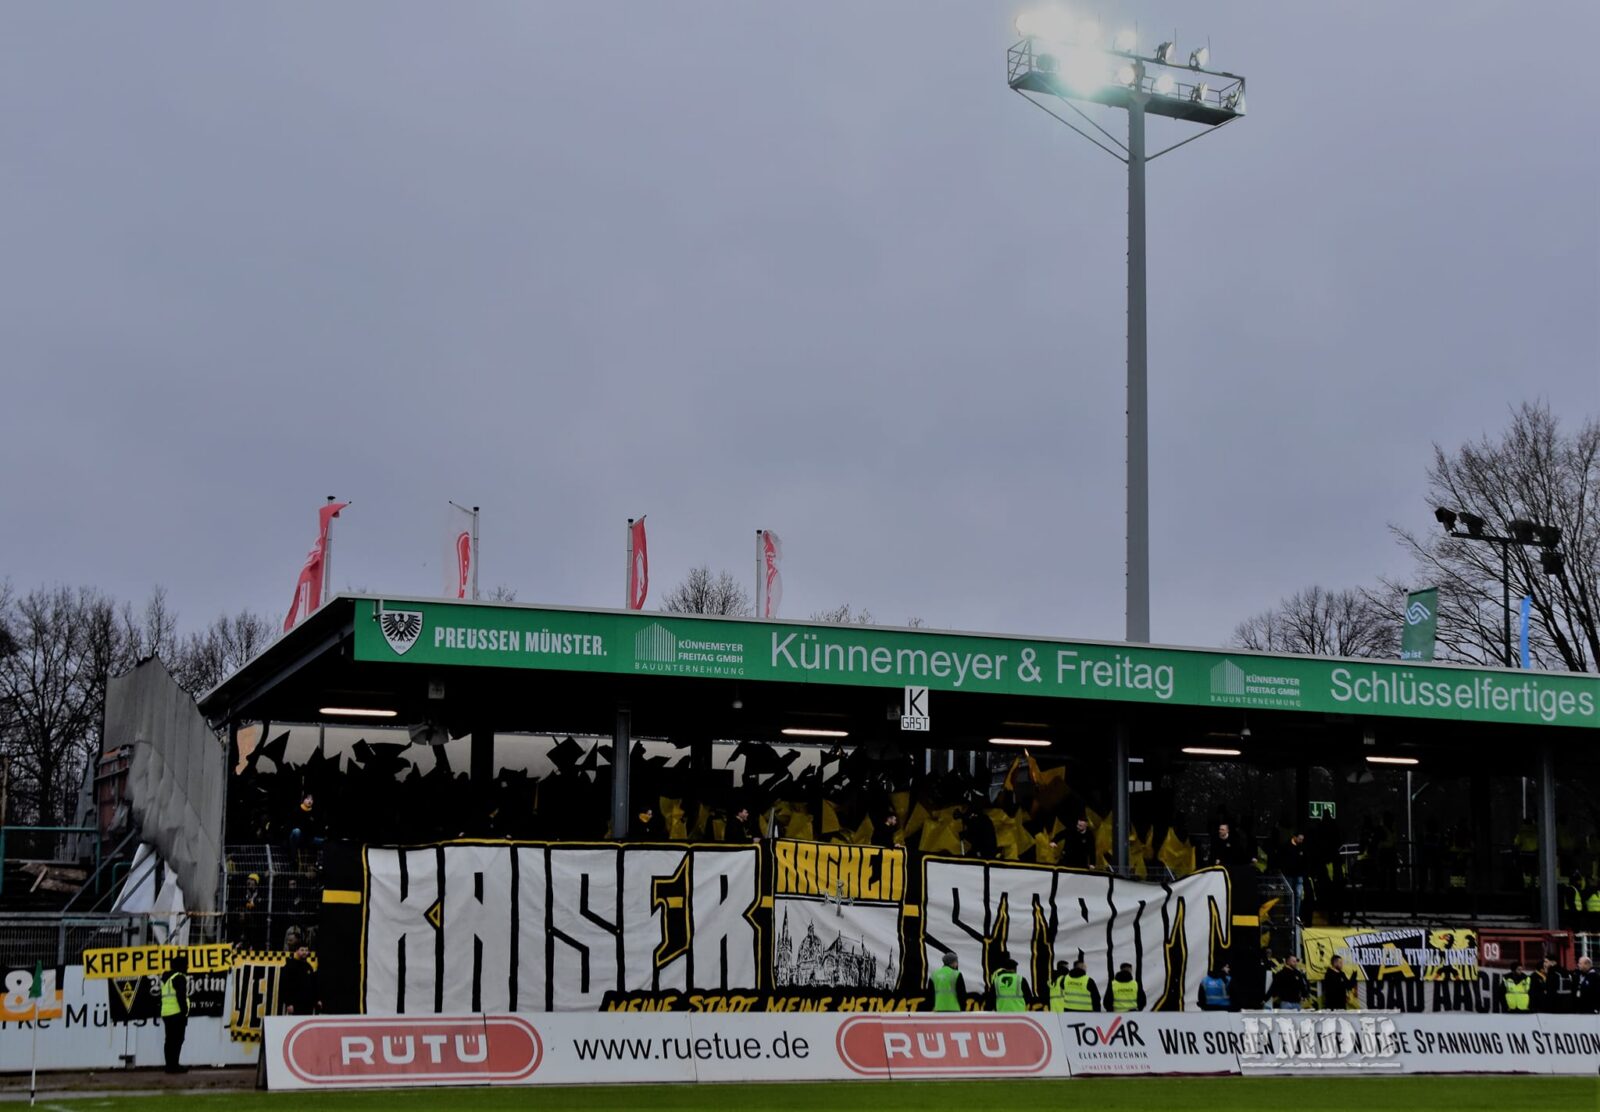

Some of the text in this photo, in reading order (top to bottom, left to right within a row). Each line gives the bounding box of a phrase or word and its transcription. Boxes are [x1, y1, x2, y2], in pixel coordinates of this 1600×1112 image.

[434, 626, 608, 656] PREUSSEN MÜNSTER.
[678, 640, 744, 653] KÜNNEMEYER
[634, 662, 745, 675] BAUUNTERNEHMUNG
[678, 652, 743, 663] FREITAG GMBH
[771, 631, 1174, 699] Künnemeyer & Freitag
[1246, 674, 1300, 686] KÜNNEMEYER
[1246, 686, 1300, 697] FREITAG GMBH
[909, 689, 924, 717] K
[1330, 668, 1594, 722] Schlüsselfertiges
[902, 716, 929, 730] GAST
[775, 842, 903, 900] AACHEN
[367, 846, 759, 1012] KAISER
[1483, 942, 1500, 961] 09
[341, 1034, 488, 1065] RÜTÜ
[573, 1031, 810, 1061] www.ruetue.de
[883, 1032, 1007, 1060] RÜTÜ
[1158, 1028, 1200, 1055] WIR
[1413, 1028, 1504, 1055] SPANNUNG
[1507, 1032, 1531, 1055] IM
[1532, 1030, 1600, 1055] STADION
[1079, 1051, 1148, 1060] ELEKTROTECHNIK
